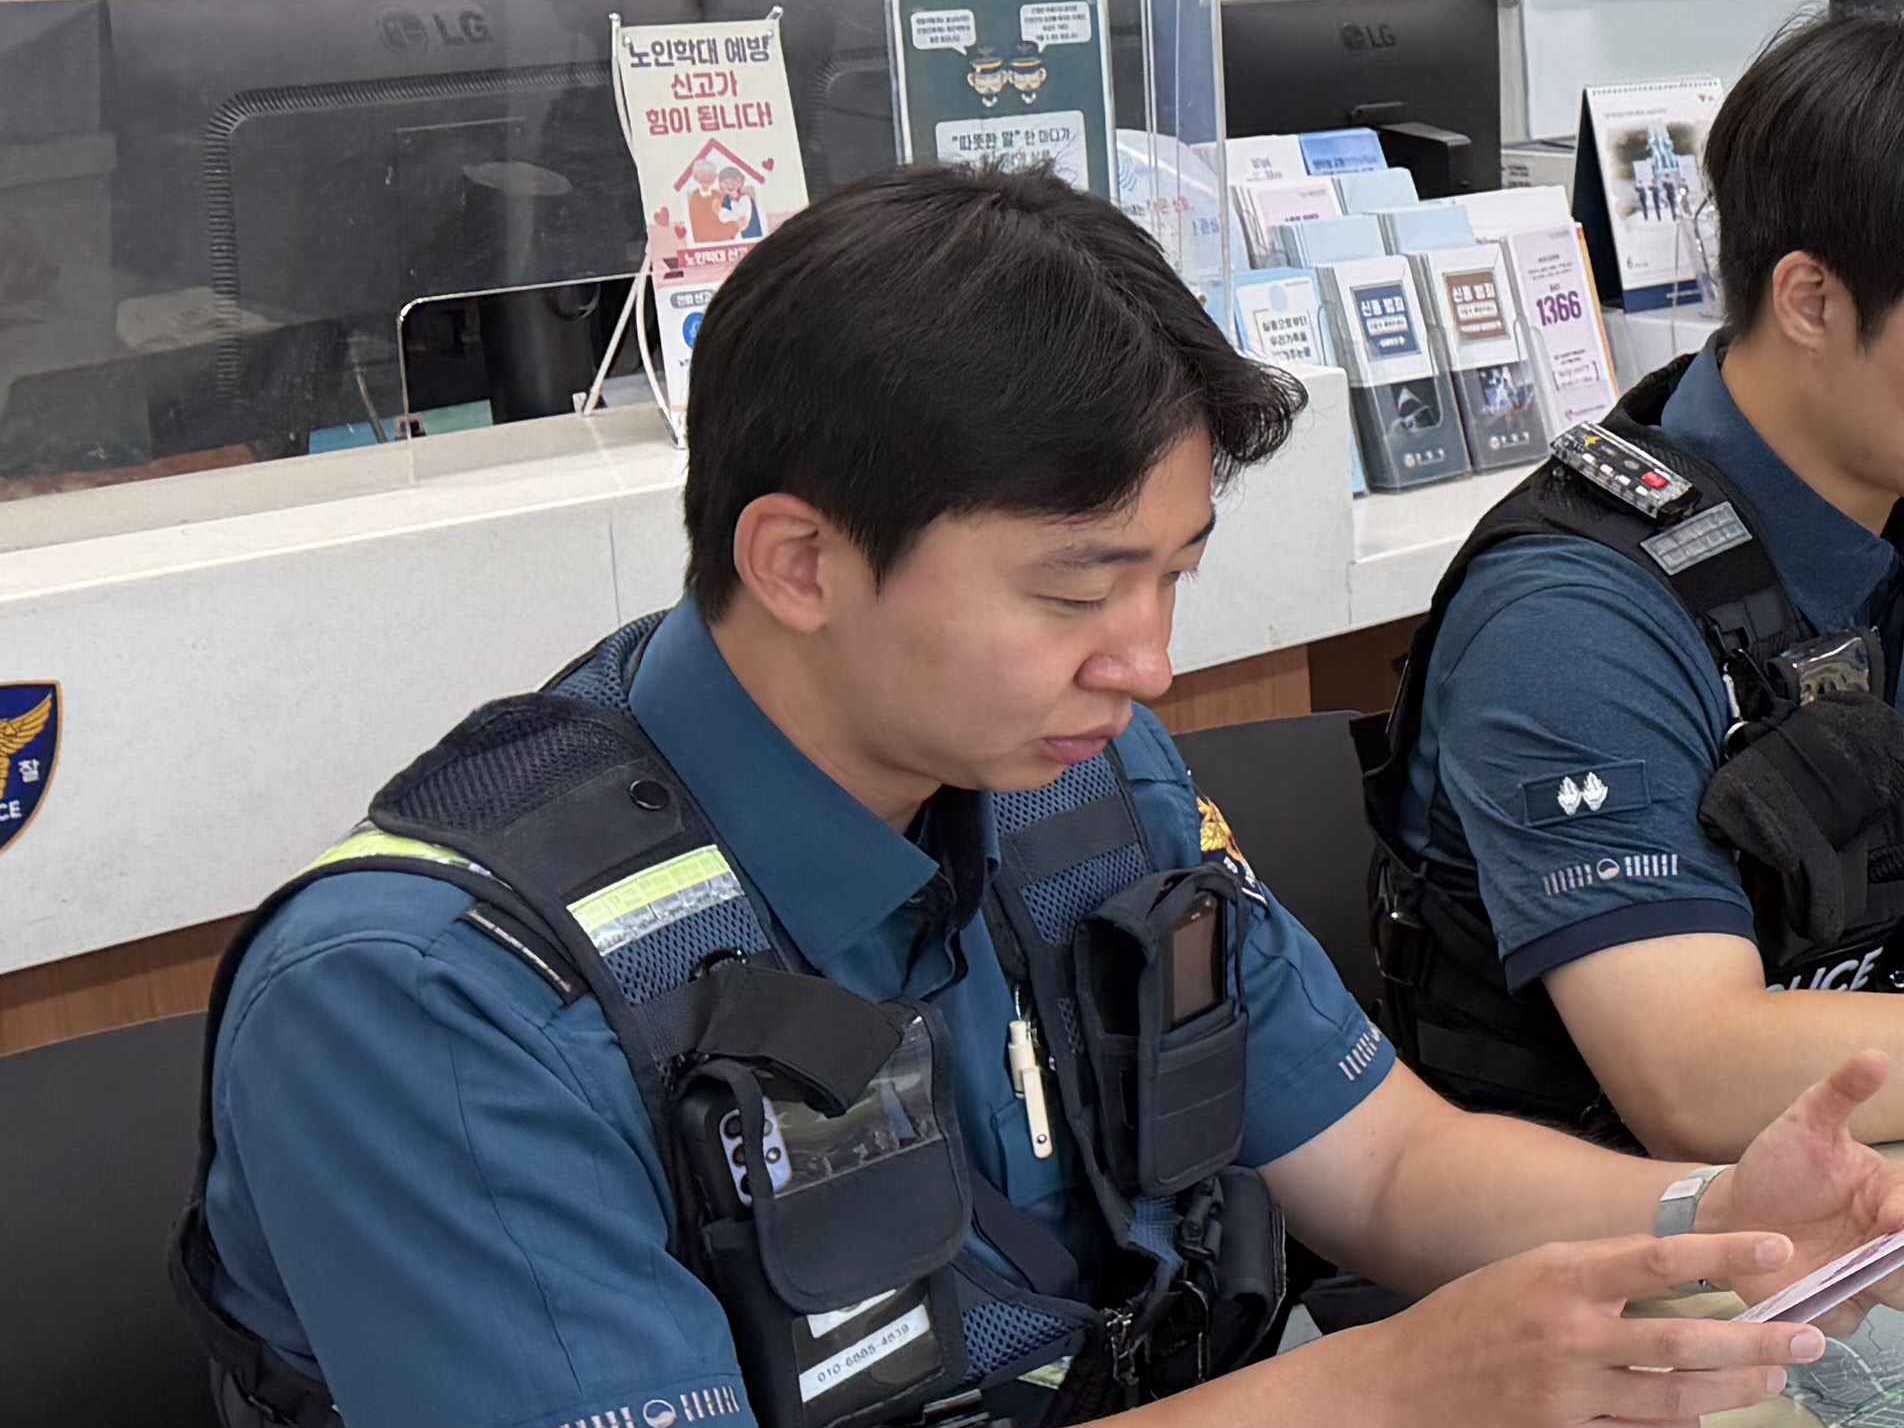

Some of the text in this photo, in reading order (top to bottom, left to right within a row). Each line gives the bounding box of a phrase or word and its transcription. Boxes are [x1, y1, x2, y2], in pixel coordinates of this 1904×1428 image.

[432, 11, 493, 47] LG
[1366, 23, 1396, 48] LG
[630, 35, 771, 68] 노인학대 예방
[671, 70, 738, 100] 신고가
[645, 101, 774, 136] 힘이 됩니다!
[1536, 291, 1582, 327] 1366
